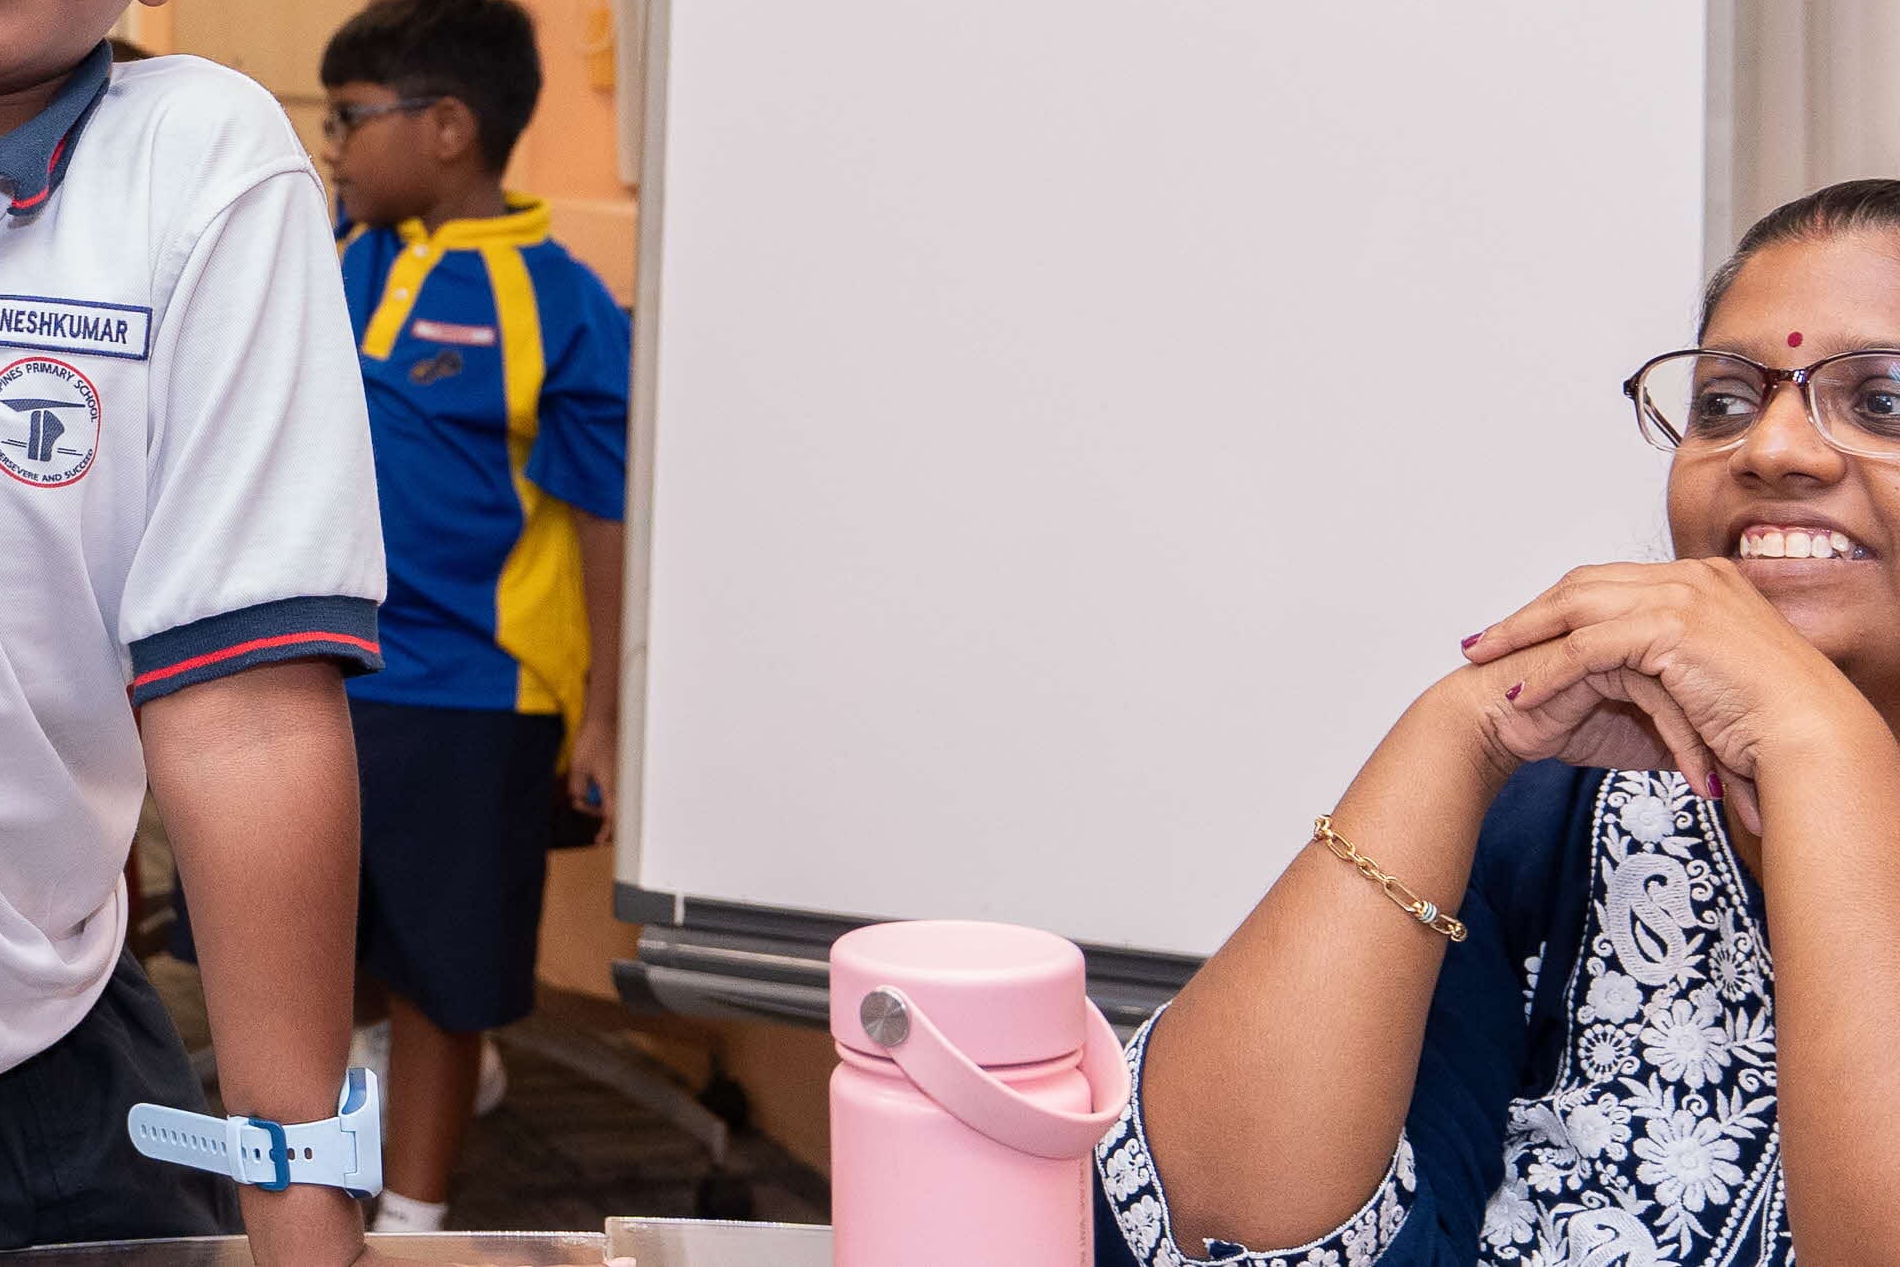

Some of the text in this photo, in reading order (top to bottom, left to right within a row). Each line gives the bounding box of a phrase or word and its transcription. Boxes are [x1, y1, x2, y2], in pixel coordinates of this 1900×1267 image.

[26, 362, 74, 382] PRIMARY
[73, 380, 98, 423] SCHOOL
[41, 474, 63, 483] AND
[64, 448, 93, 479] SUCCEED
